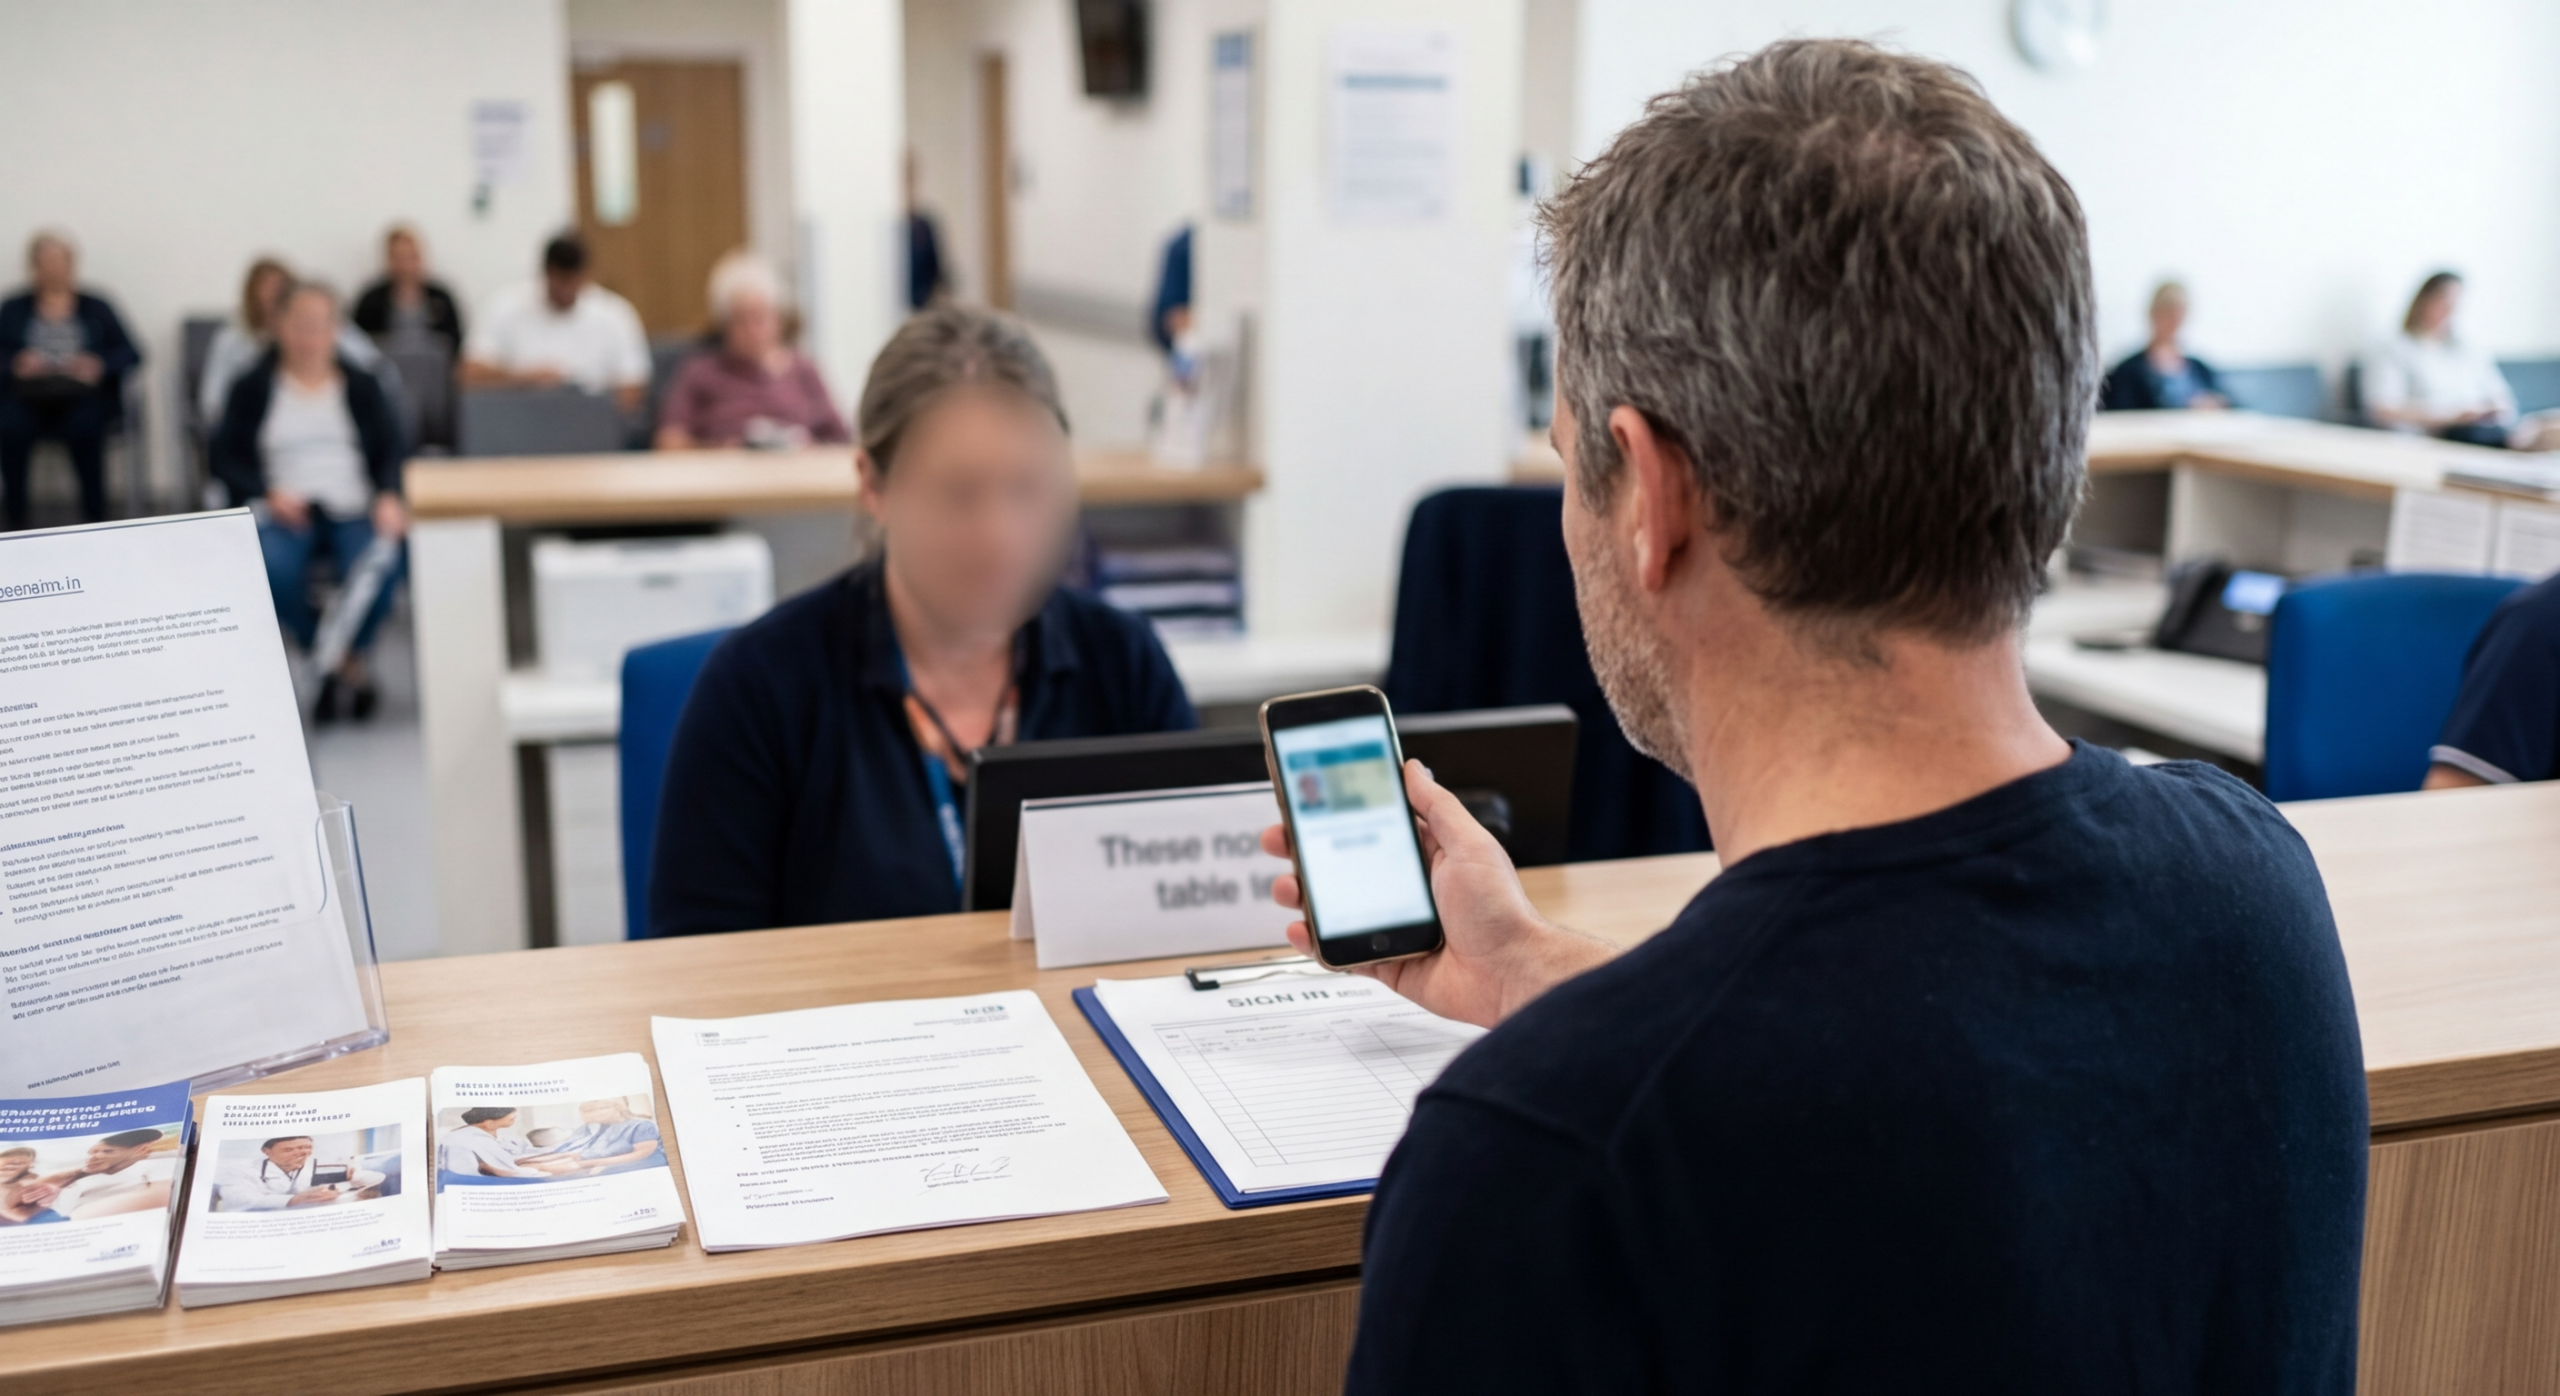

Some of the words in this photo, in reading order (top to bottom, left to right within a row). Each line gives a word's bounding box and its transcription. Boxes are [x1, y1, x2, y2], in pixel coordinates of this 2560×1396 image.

[1099, 834, 1203, 868] These
[1212, 831, 1262, 859] no
[1156, 872, 1240, 910] table
[1227, 993, 1295, 1008] SIGN
